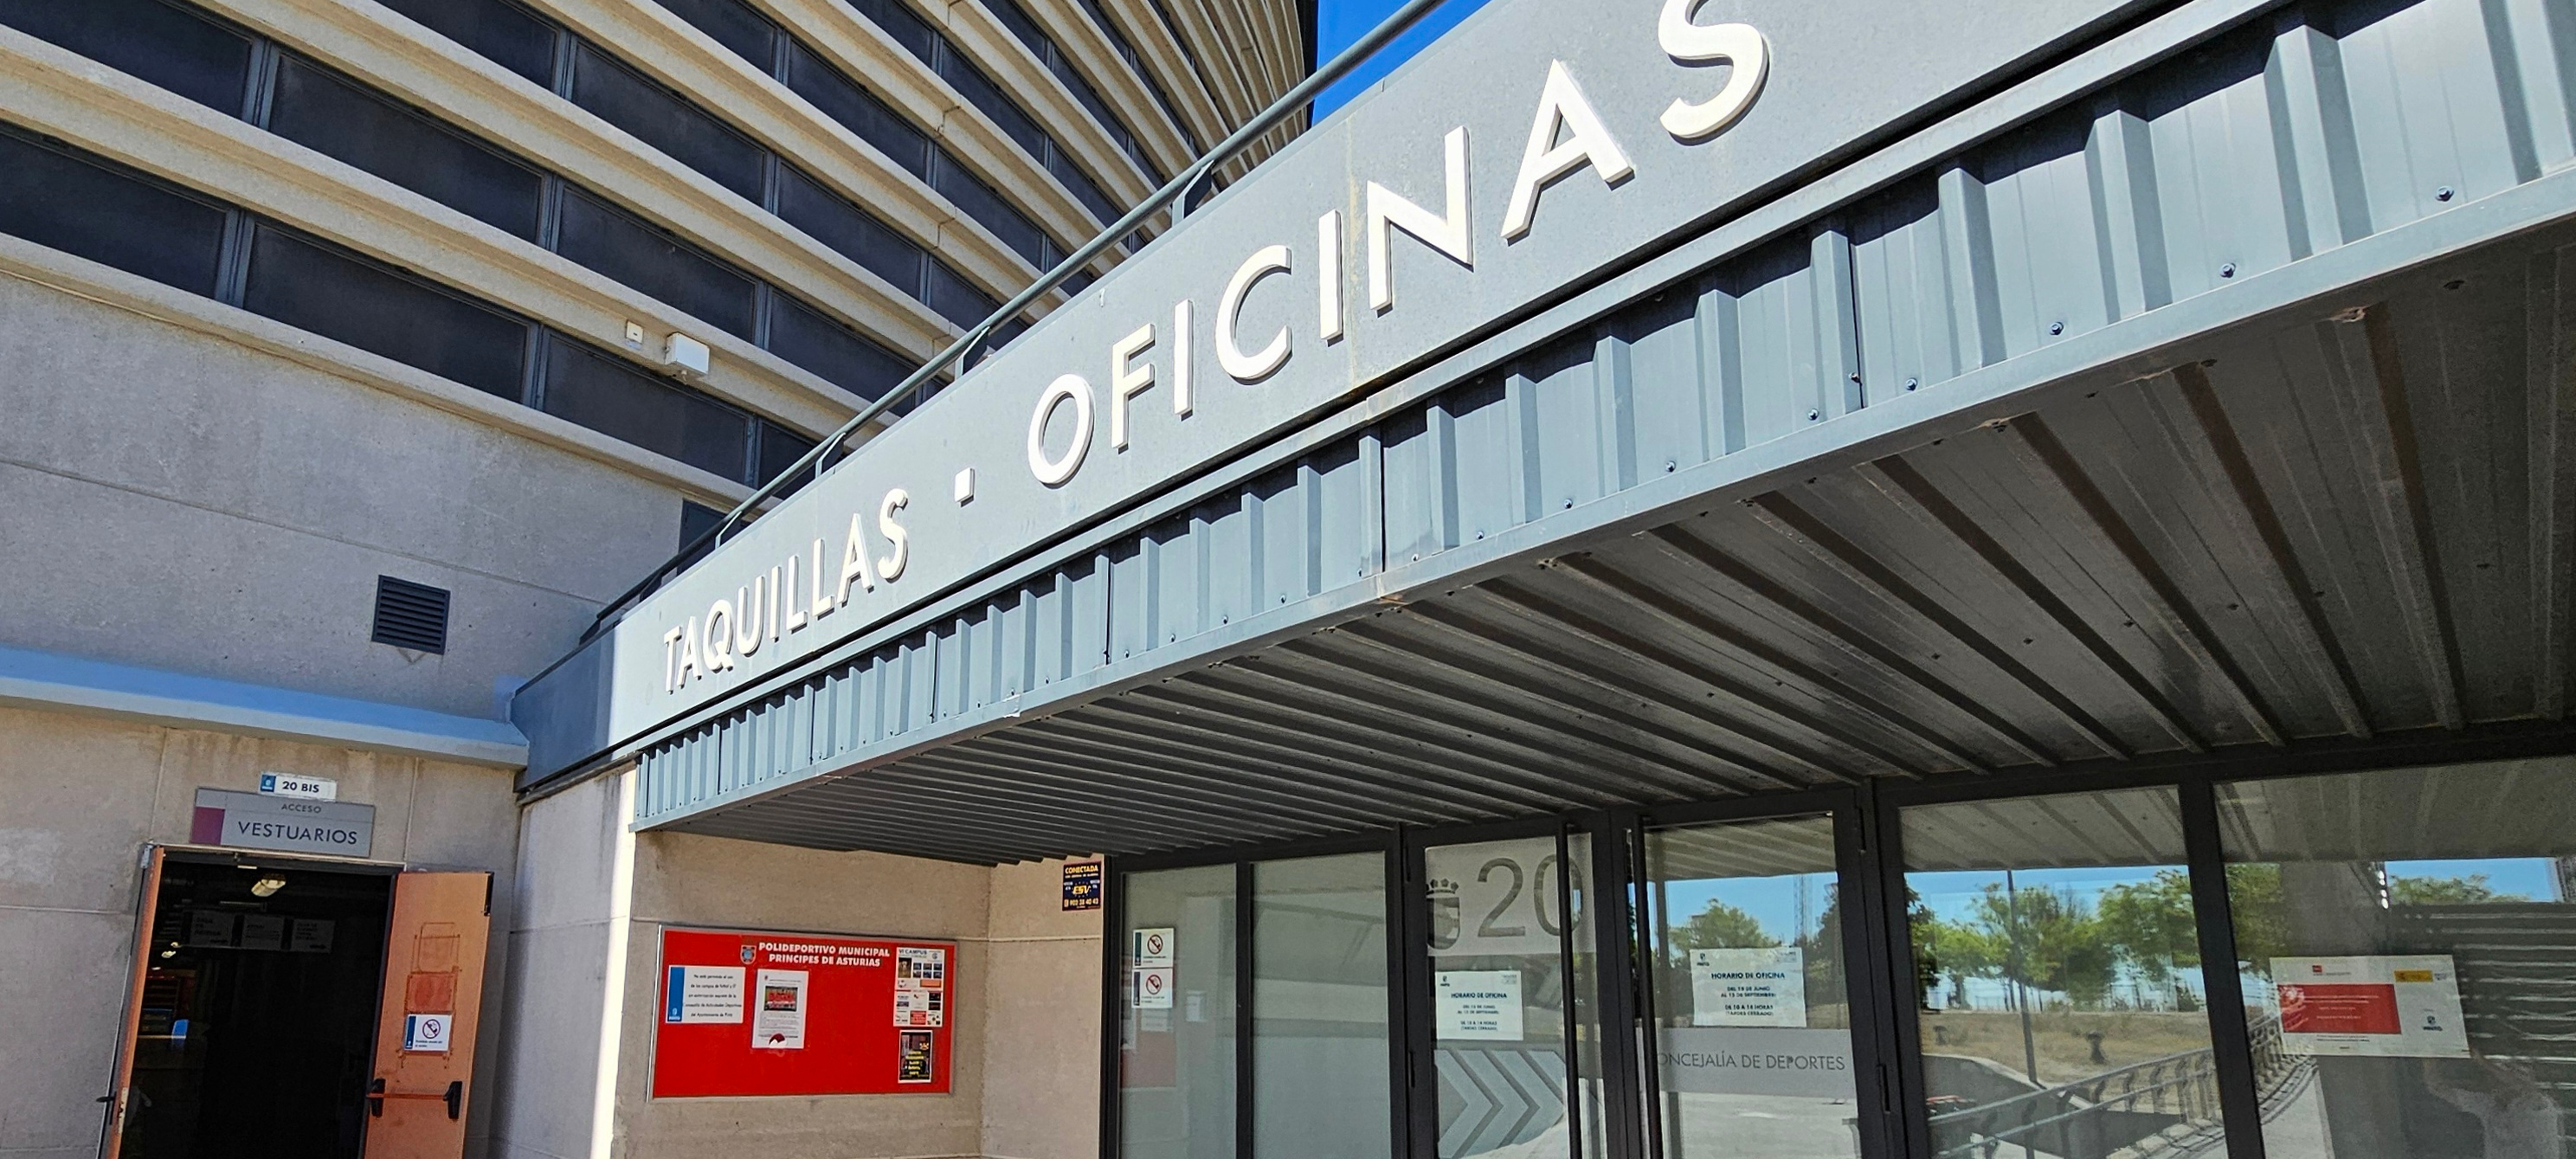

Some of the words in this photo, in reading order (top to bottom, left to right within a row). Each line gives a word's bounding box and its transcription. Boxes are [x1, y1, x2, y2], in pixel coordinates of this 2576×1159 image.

[663, 487, 909, 695] TAQUILLAS
[1027, 0, 1770, 486] OFICINAS
[282, 781, 297, 791] 20
[301, 782, 319, 793] BIS
[281, 803, 321, 814] ACCESO
[238, 821, 357, 845] VESTUARIOS
[1065, 865, 1098, 874] CONECTADA
[1477, 853, 1583, 937] 20
[758, 942, 836, 955] POLIDEPORTIVO
[838, 945, 891, 957] MUNICIPAL
[769, 954, 820, 964] PRINCIPES
[821, 956, 834, 965] DE
[836, 956, 880, 967] ASTURIAS
[1658, 1049, 1737, 1068] ONCEJALÍA
[1742, 1054, 1761, 1069] DE
[1766, 1055, 1845, 1071] DEPORTES
